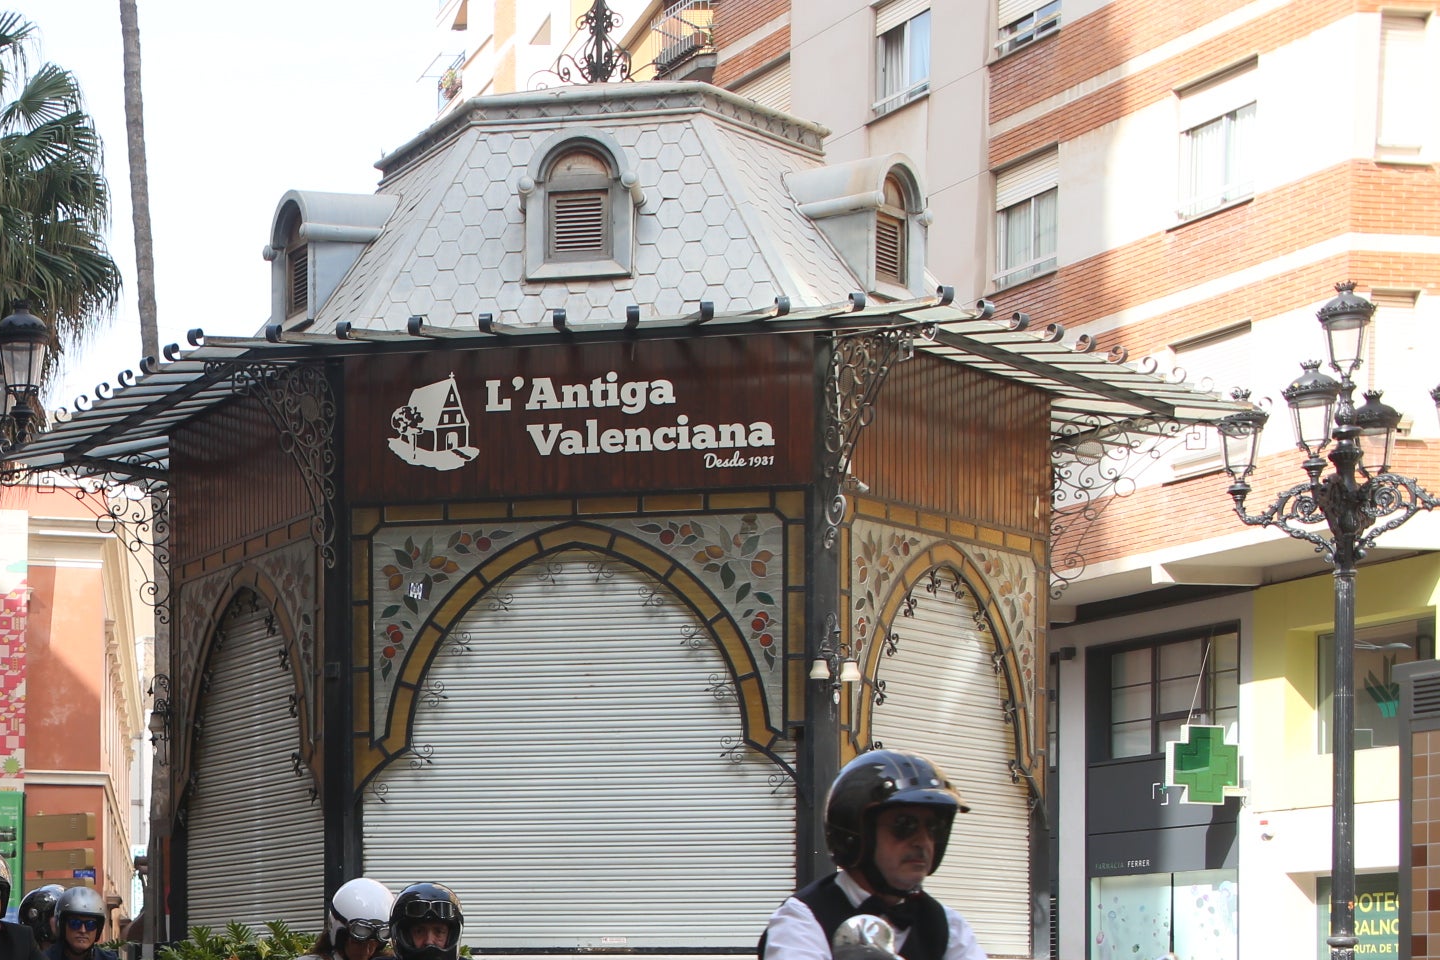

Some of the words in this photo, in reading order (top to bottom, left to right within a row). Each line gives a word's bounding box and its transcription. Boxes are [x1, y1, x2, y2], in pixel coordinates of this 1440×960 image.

[485, 371, 676, 414] L'Antiga
[526, 414, 776, 456] Valenciana
[703, 450, 747, 469] Desde
[1127, 859, 1150, 868] FERRER
[1379, 943, 1392, 953] DE
